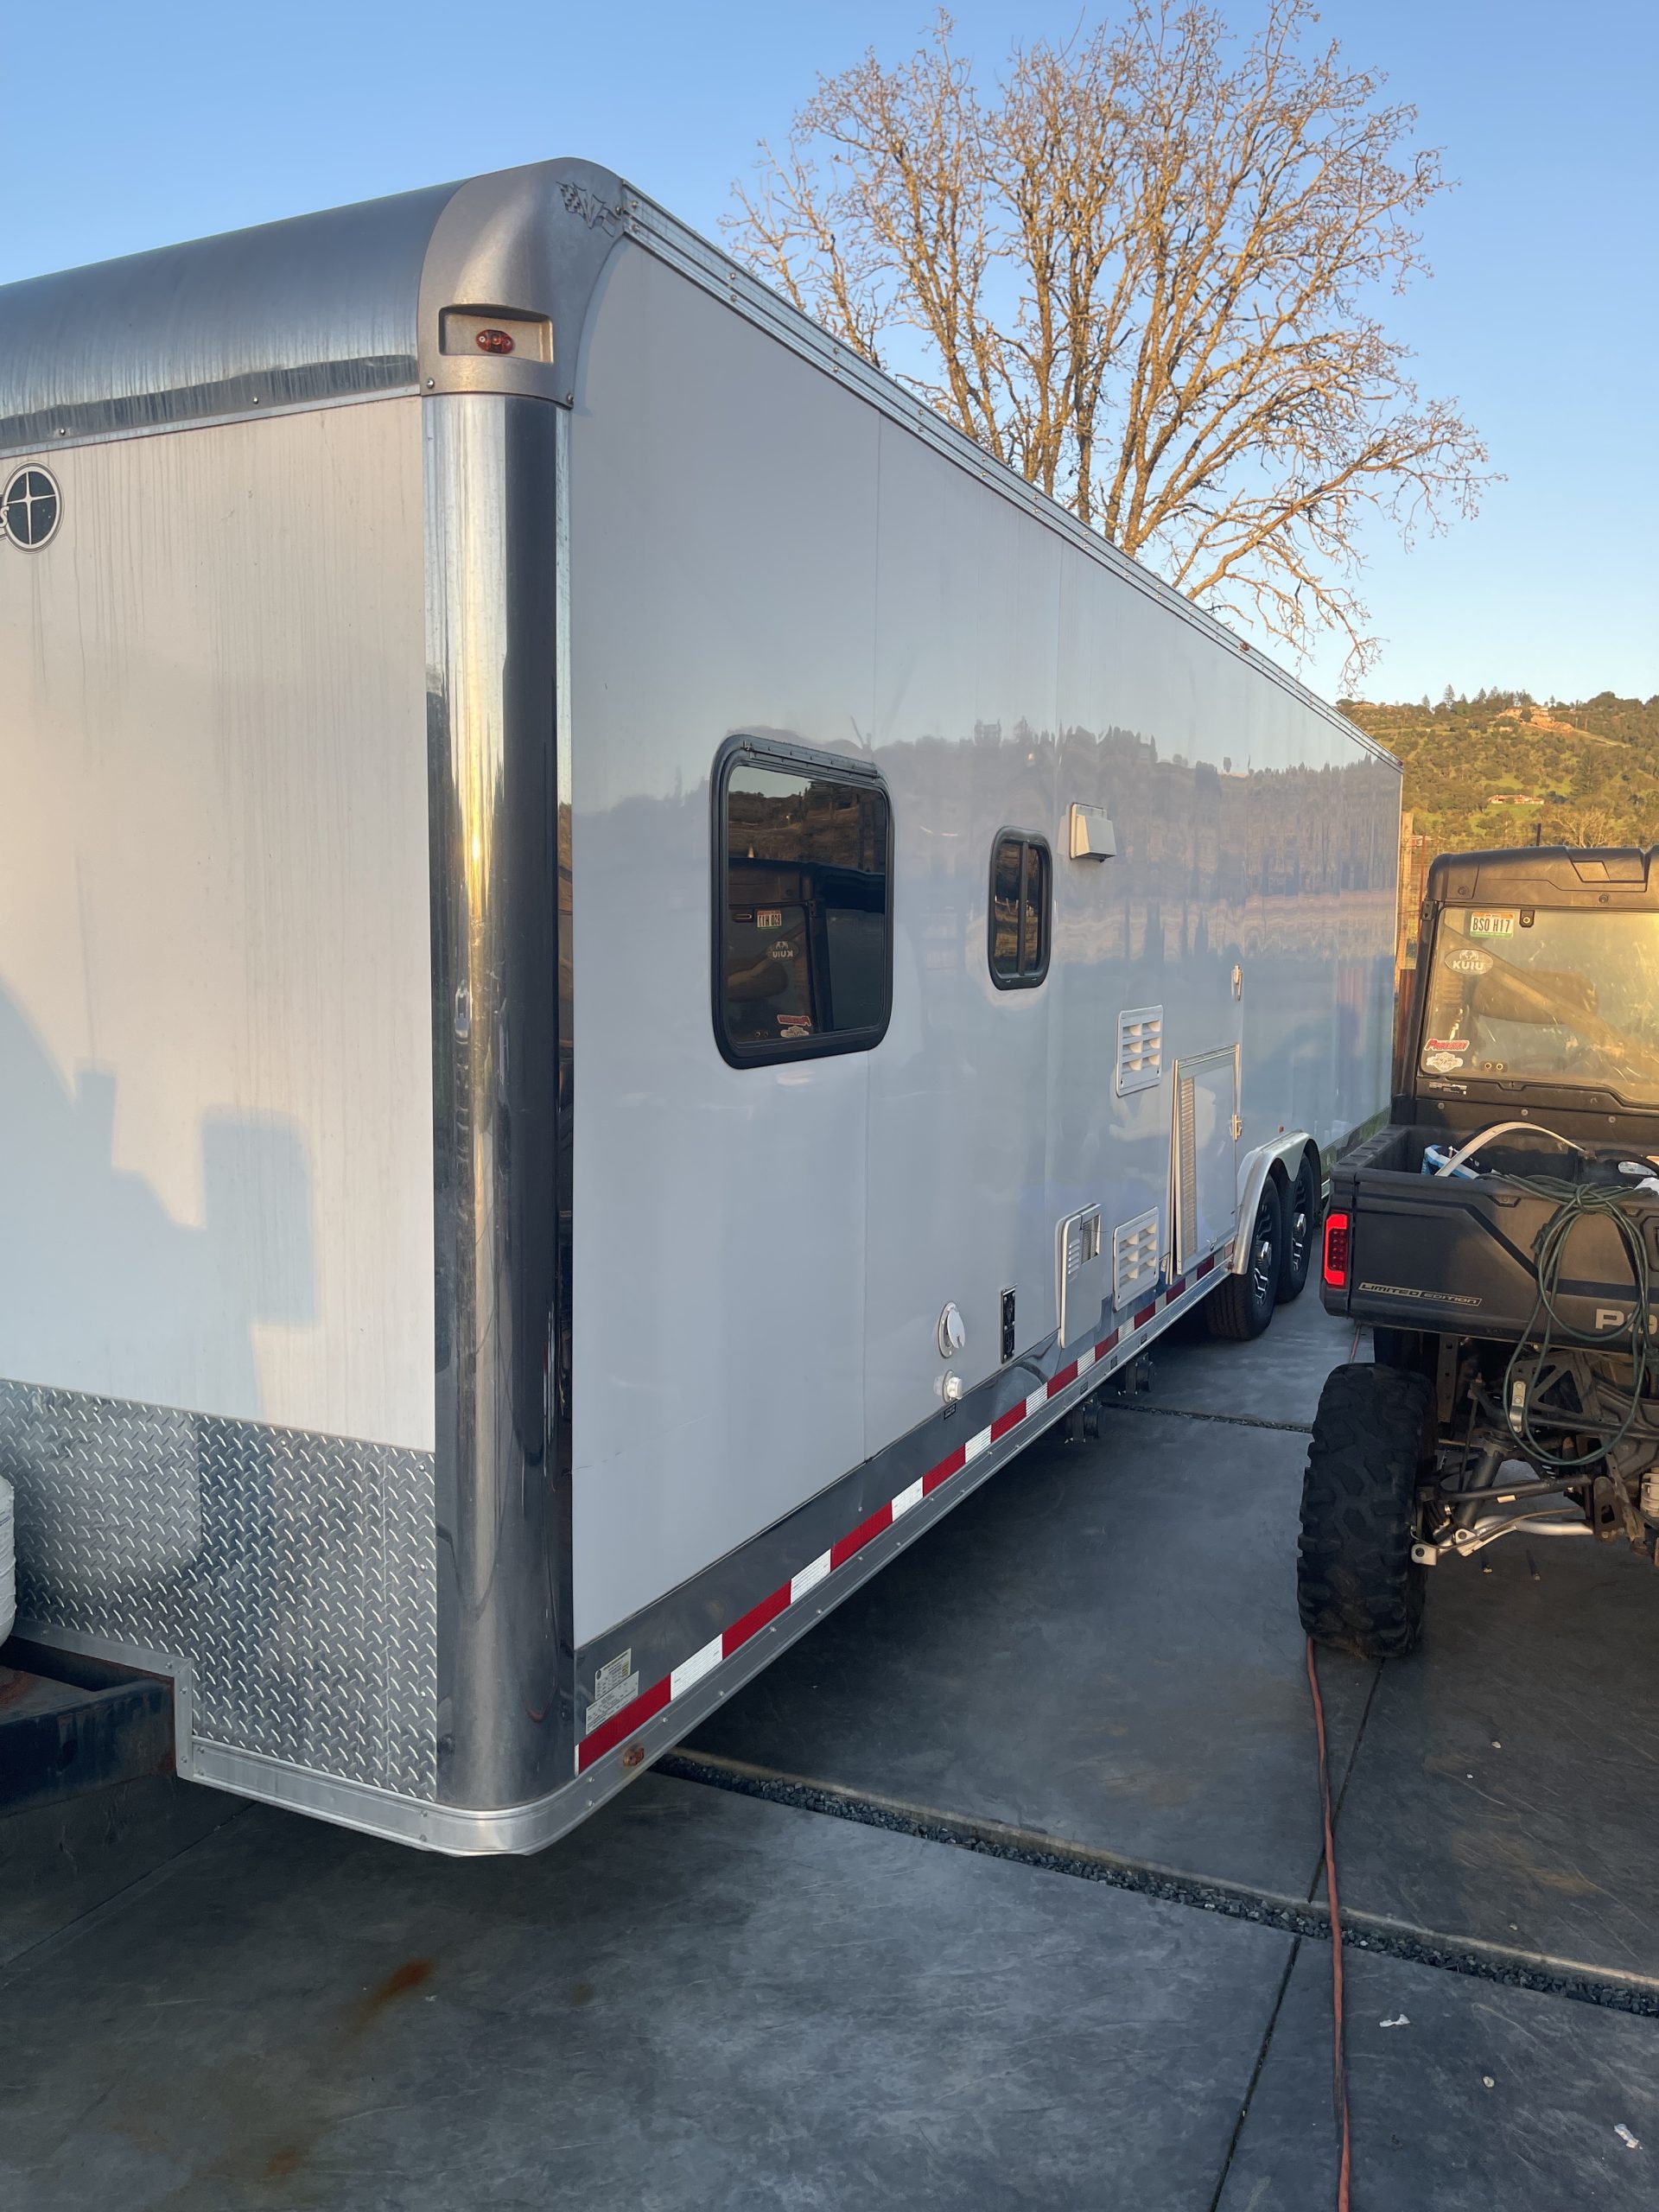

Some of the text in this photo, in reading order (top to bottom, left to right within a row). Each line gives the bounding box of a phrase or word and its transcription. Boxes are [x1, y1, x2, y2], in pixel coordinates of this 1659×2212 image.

[1452, 960, 1485, 970] KUIU
[1362, 1284, 1477, 1305] LIMITED EDITION
